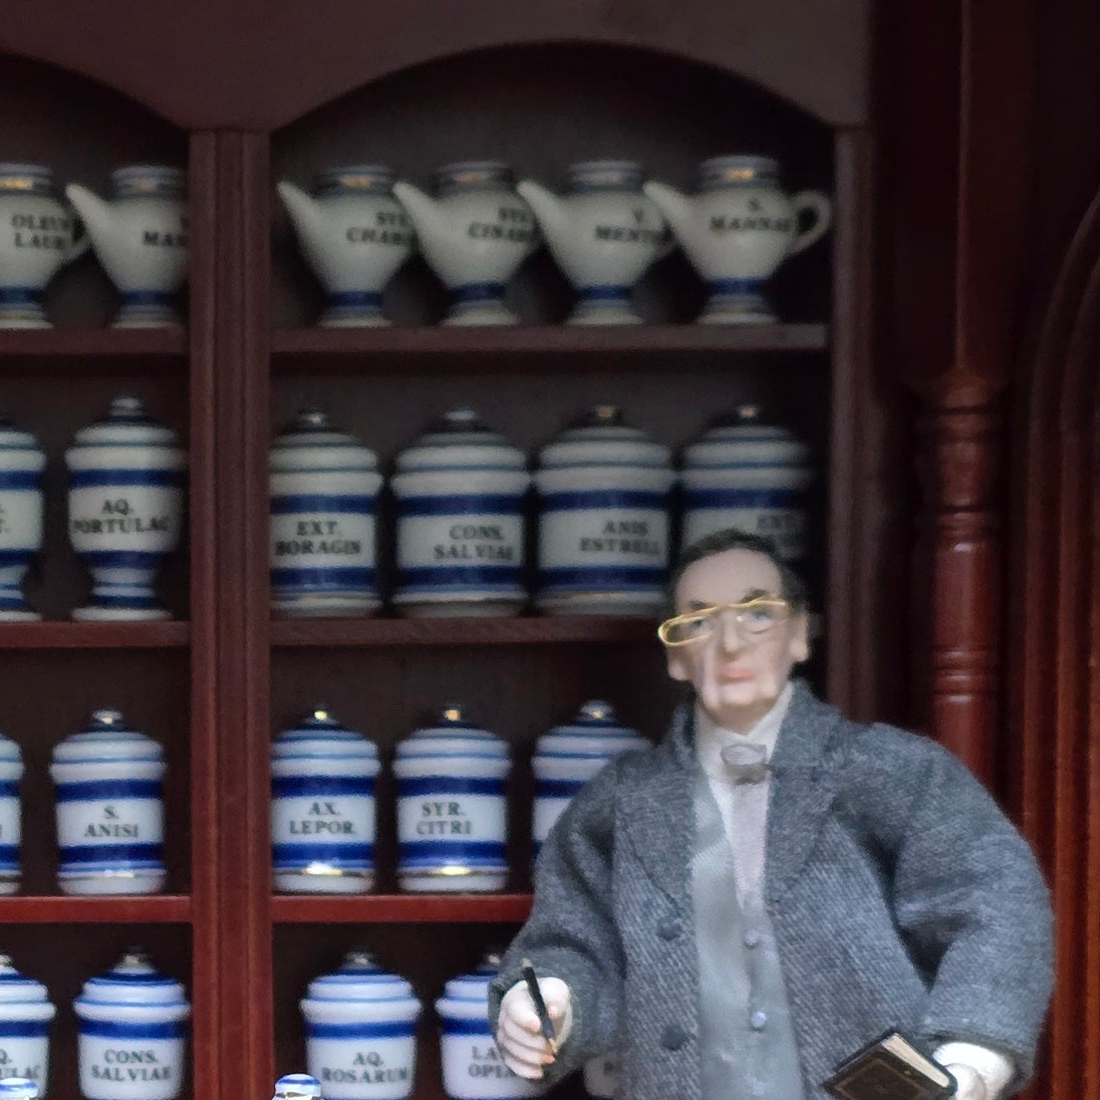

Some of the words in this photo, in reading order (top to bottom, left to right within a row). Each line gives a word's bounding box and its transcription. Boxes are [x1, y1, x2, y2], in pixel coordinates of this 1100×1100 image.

[421, 801, 464, 817] SYR.
[416, 819, 472, 837] CITRI
[104, 1050, 159, 1066] CONS.
[92, 1066, 172, 1082] SALVIAE
[321, 1067, 408, 1083] ROSARUM
